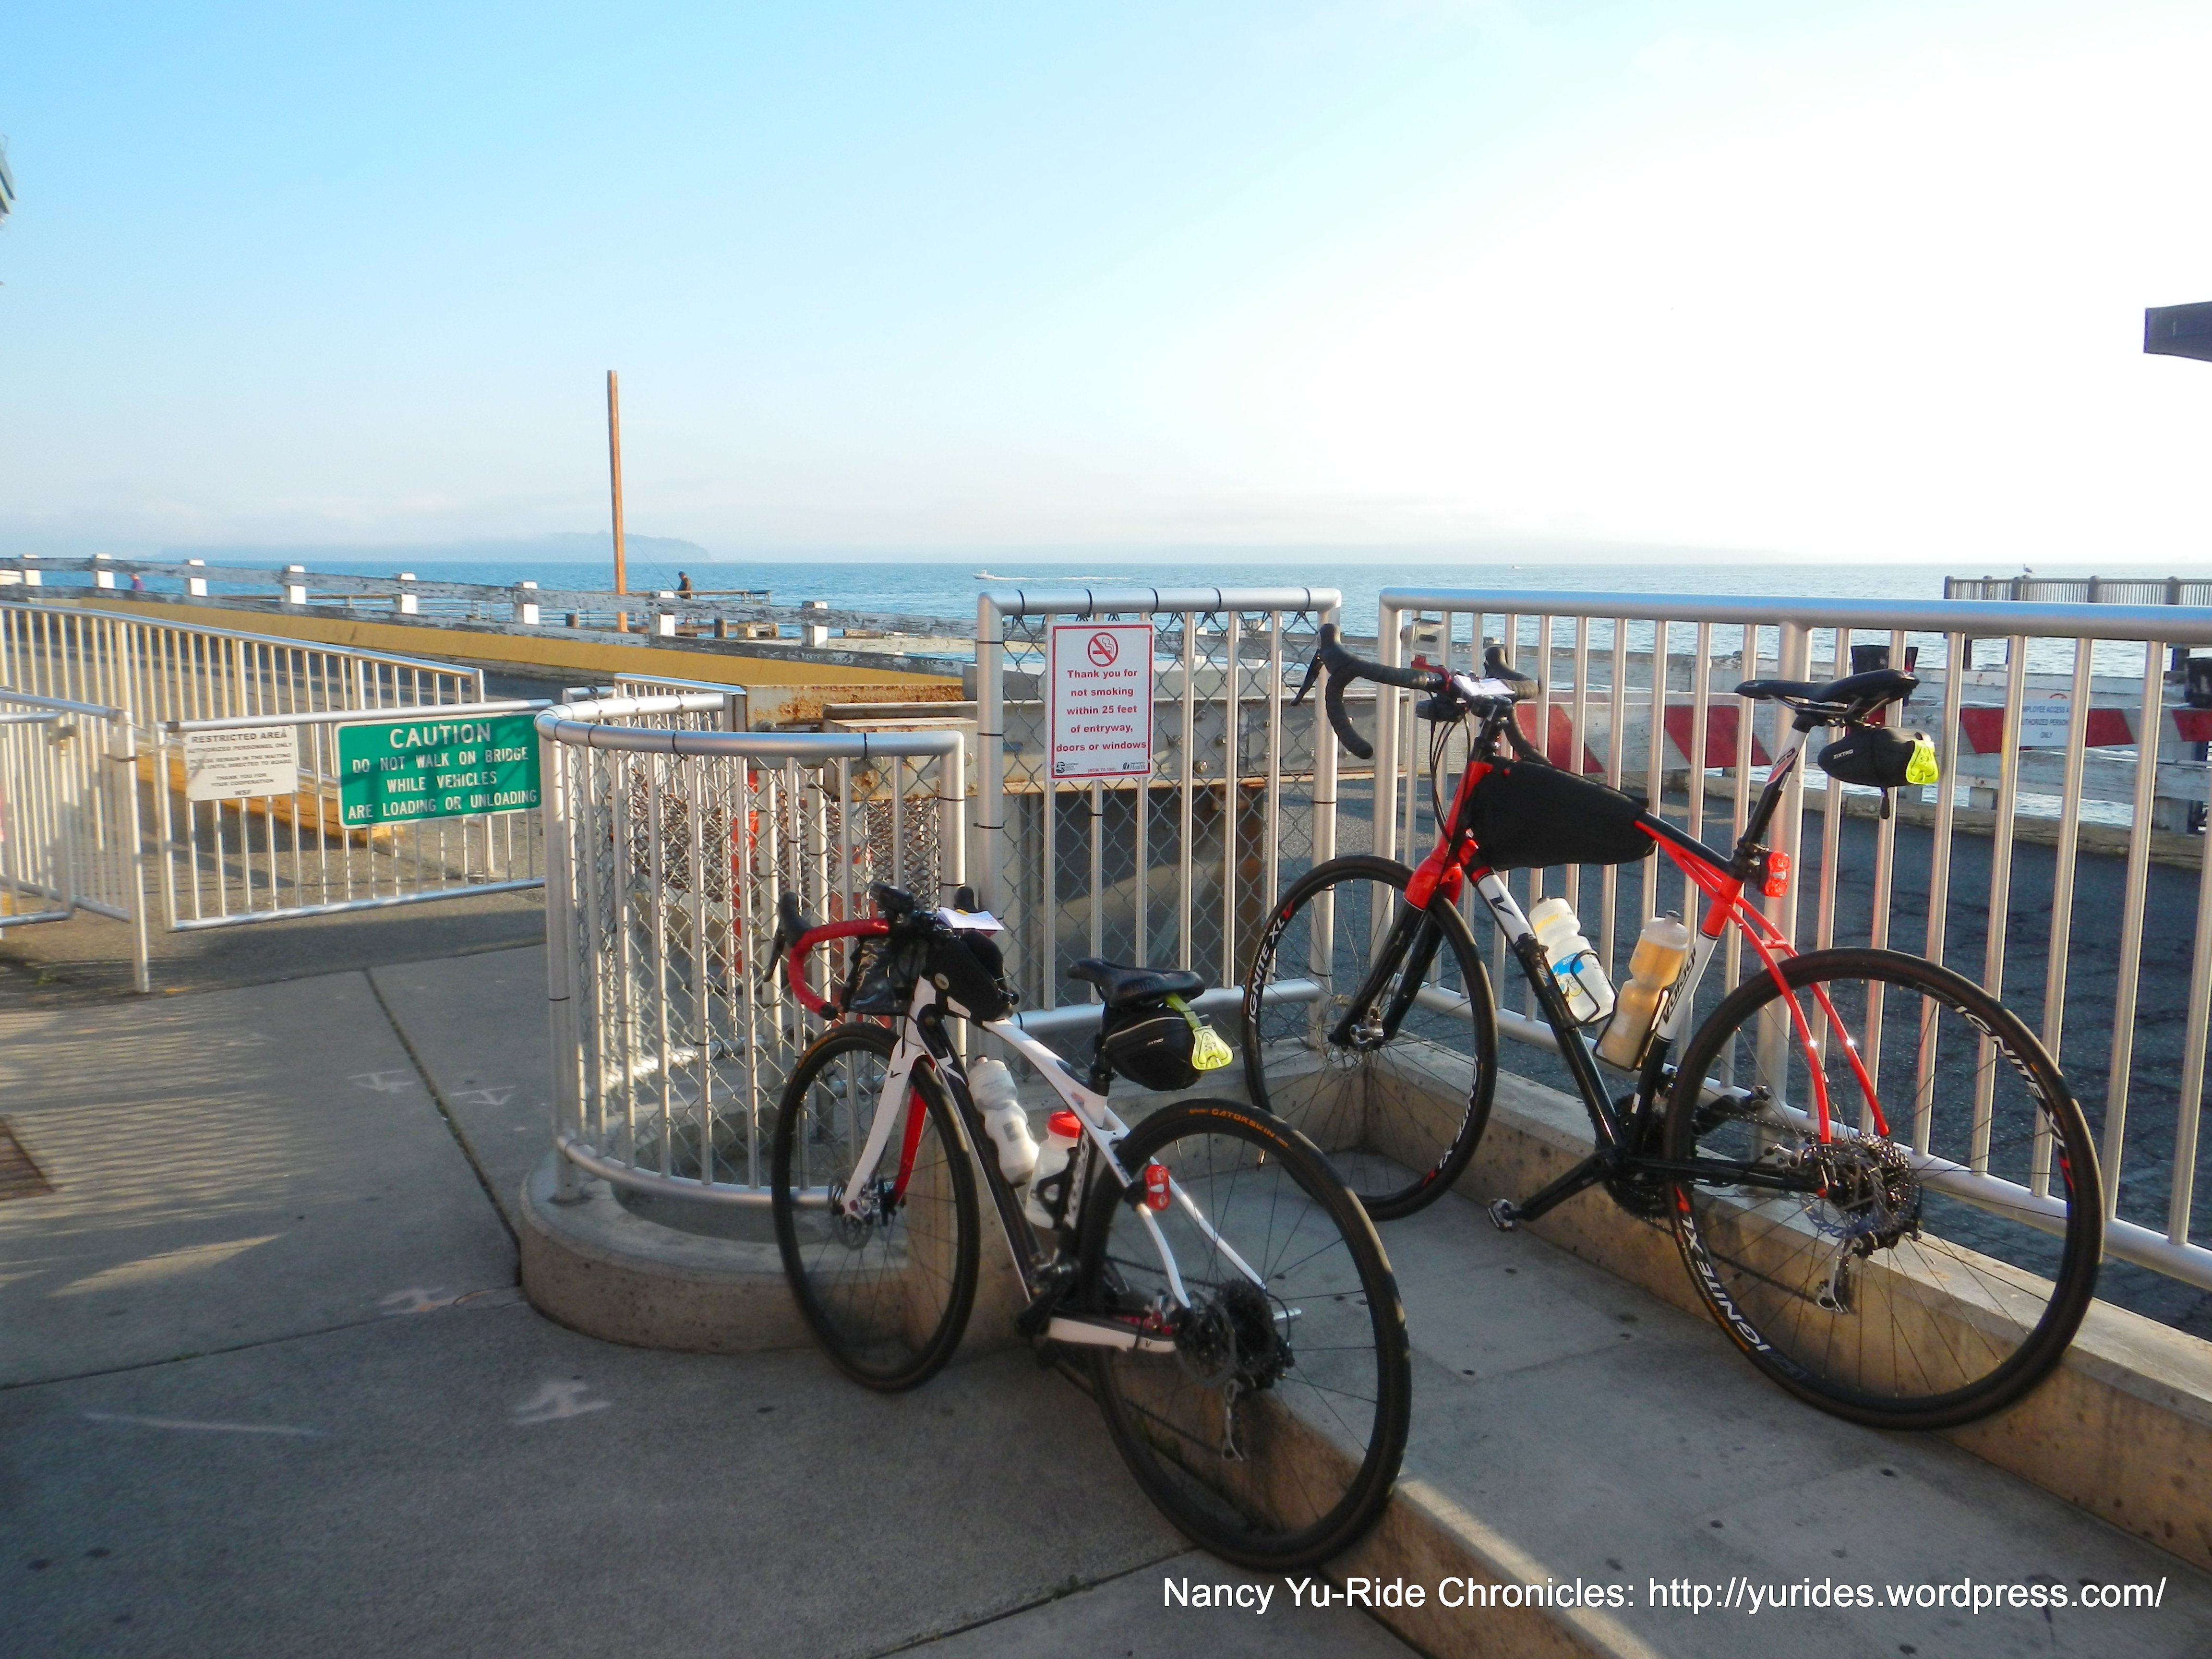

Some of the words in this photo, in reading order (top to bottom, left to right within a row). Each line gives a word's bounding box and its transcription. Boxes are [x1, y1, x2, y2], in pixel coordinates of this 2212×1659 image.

[1067, 670, 1099, 679] Thank
[1103, 670, 1120, 679] you
[1124, 669, 1138, 677] for
[1091, 687, 1133, 697] smoking
[1102, 706, 1114, 714] 25
[1117, 705, 1137, 713] feet
[192, 733, 257, 743] RESTRICTED
[390, 723, 491, 748] CAUTION
[1070, 724, 1081, 733] of
[1083, 723, 1133, 733] entryway,
[1056, 743, 1085, 752] doors
[1102, 741, 1147, 750] windows
[352, 758, 370, 773] DO
[380, 756, 405, 771] NOT
[416, 753, 449, 768] WALK
[459, 751, 476, 765] ON
[485, 746, 528, 763] BRIDGE
[387, 777, 426, 793] WHILE
[436, 771, 497, 789] VEHICLES
[349, 804, 373, 819] ARE
[383, 798, 436, 817] LOADING
[445, 796, 462, 810] OR
[470, 789, 537, 808] UNLOADING
[1249, 943, 1270, 1024] IGNITE
[1269, 917, 1285, 944] XL
[1955, 1006, 2045, 1099] IGNITE
[1211, 1108, 1275, 1138] GATORSKIN
[1682, 1216, 1704, 1254] XL
[1696, 1260, 1771, 1351] IGNITE
